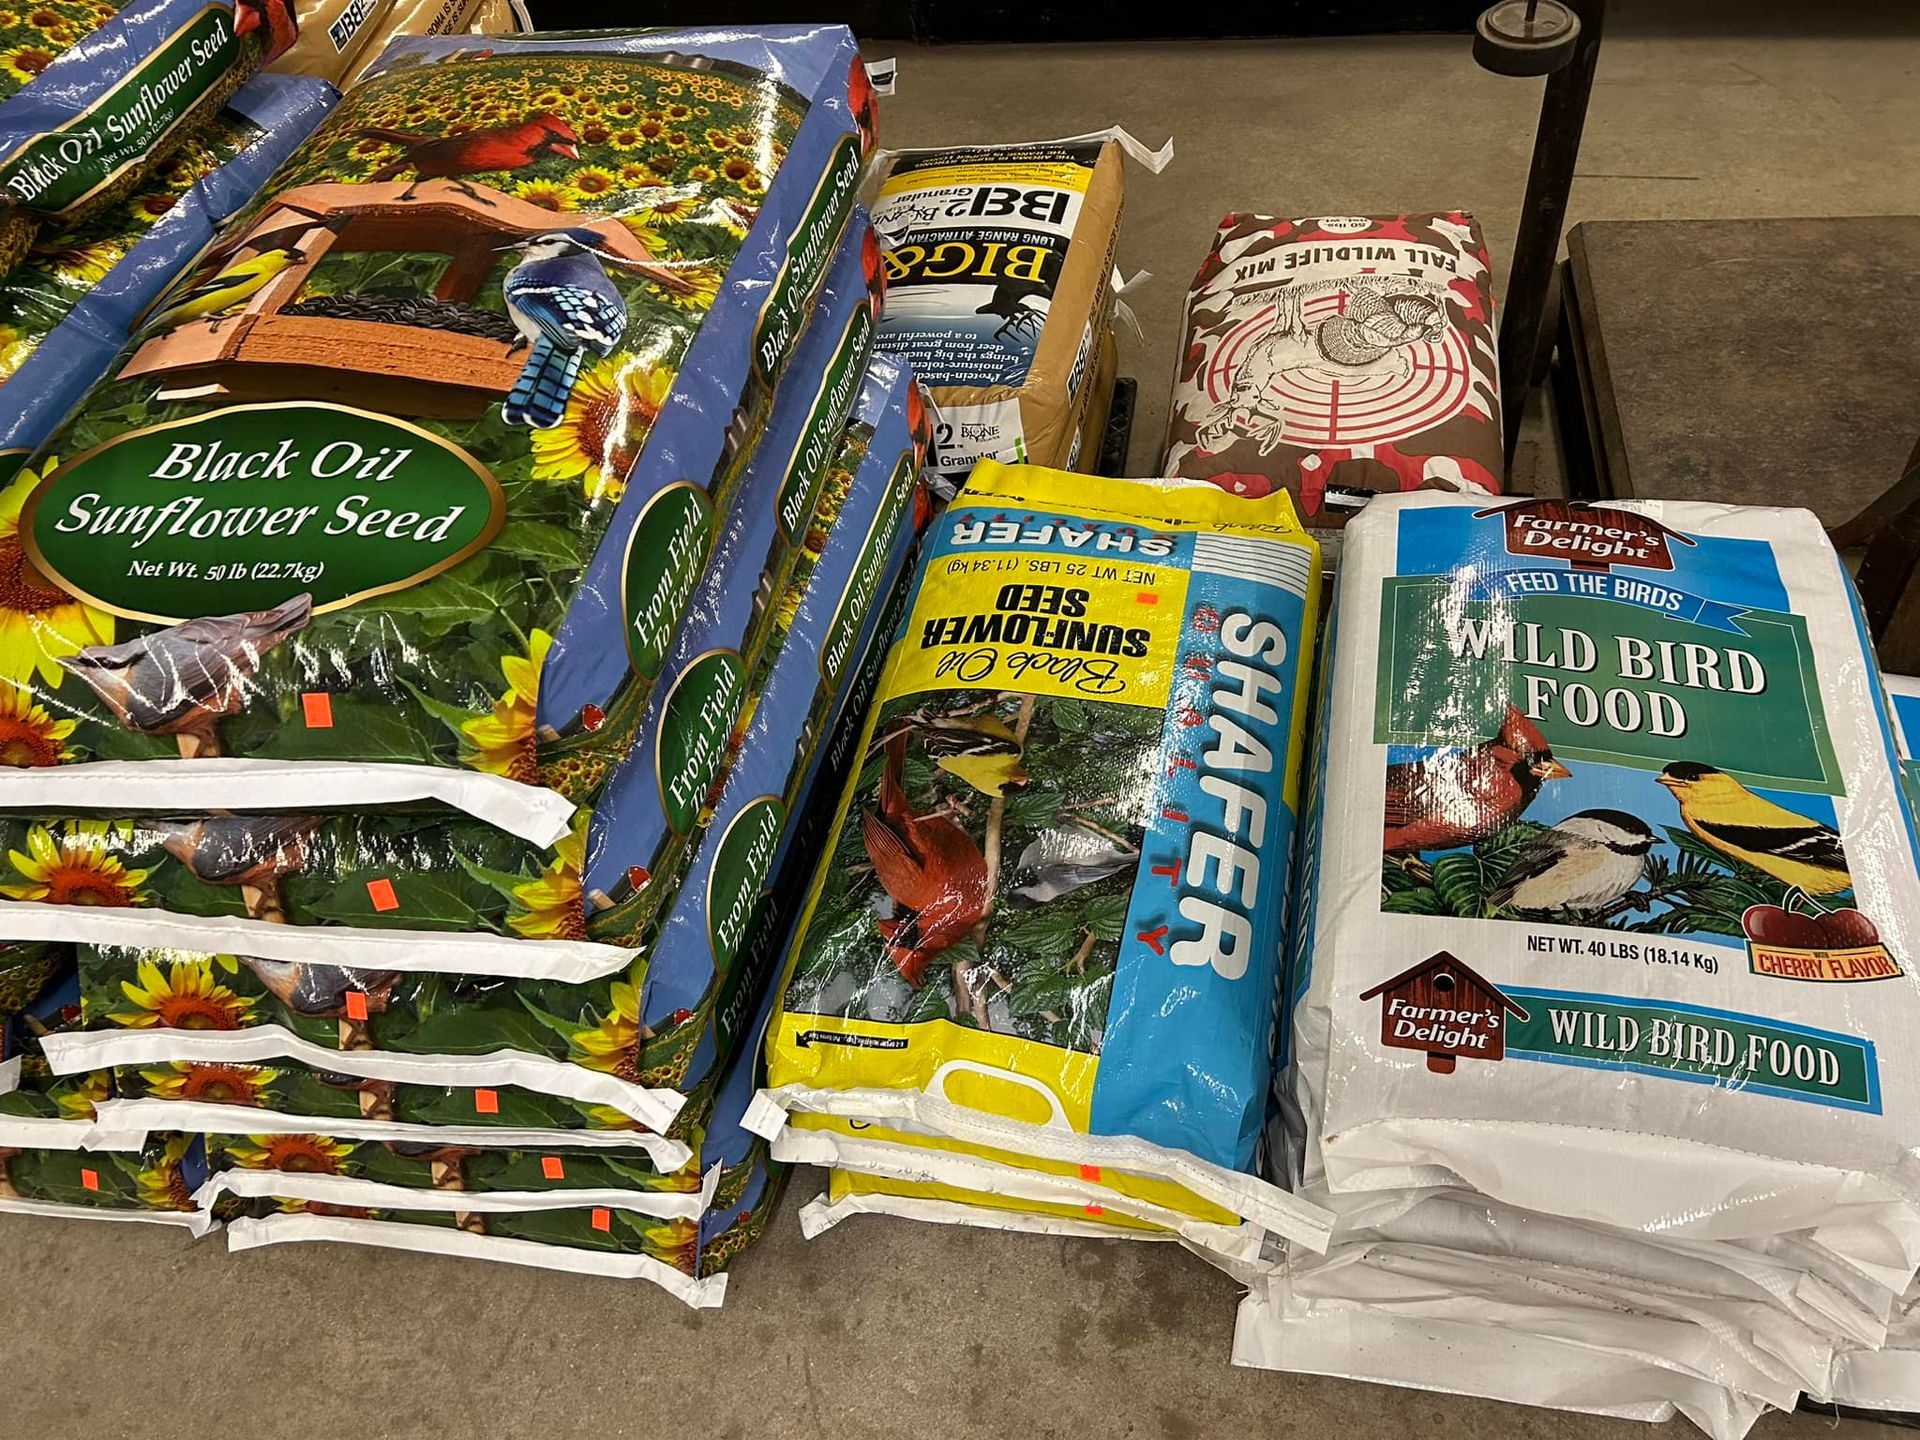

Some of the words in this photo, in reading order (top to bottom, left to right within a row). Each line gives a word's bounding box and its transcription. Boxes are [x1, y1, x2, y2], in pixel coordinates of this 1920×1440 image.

[8, 152, 68, 202] Black
[106, 62, 194, 144] Sunflower
[191, 18, 229, 66] Seed
[894, 187, 974, 205] Granular
[790, 194, 842, 283] Sunflower
[836, 151, 859, 192] Seed
[907, 230, 973, 244] ATTRACTAN
[976, 230, 1019, 244] RANGE
[1021, 232, 1056, 246] LONG
[1234, 257, 1276, 283] MIX
[1284, 245, 1397, 270] WILDLIFE
[1406, 248, 1459, 274] FALL
[873, 341, 907, 351] distan
[898, 330, 953, 341] powerful
[911, 341, 943, 350] great
[944, 342, 974, 352] from
[965, 332, 978, 340] to
[976, 343, 1005, 352] deer
[910, 360, 1004, 371] moisture-tolera
[933, 350, 956, 360] big
[957, 351, 978, 359] the
[980, 352, 1020, 364] brings
[913, 371, 1001, 382] Protein-based,
[782, 474, 812, 533] Black
[805, 433, 823, 475] Oil
[819, 359, 856, 437] Sunflower
[852, 312, 870, 361] Seed
[149, 438, 300, 482] Black
[309, 440, 413, 482] Oil
[54, 492, 319, 549] Sunflower
[323, 495, 466, 543] Seed
[1513, 513, 1660, 548] Farmer's
[950, 520, 1173, 557] SHAFER
[1523, 529, 1650, 560] Delight
[127, 559, 163, 578] Net
[167, 561, 199, 579] Wt.
[204, 564, 225, 582] 50
[227, 561, 247, 580] lb
[250, 561, 325, 583] (22.7kg)
[633, 575, 673, 648] From
[667, 492, 703, 571] Field
[827, 620, 853, 680] Black
[850, 583, 865, 622] Oil
[862, 508, 899, 593] Sunflower
[895, 461, 912, 508] Seed
[946, 559, 971, 576] kg)
[973, 557, 1020, 573] (11.34
[1025, 559, 1061, 574] LBS.
[1066, 563, 1086, 577] 25
[1090, 567, 1119, 582] WT
[1121, 570, 1156, 586] NET
[996, 583, 1090, 615] SEED
[1506, 570, 1561, 594] FEED
[1564, 573, 1608, 596] THE
[1613, 578, 1684, 612] BIRDS
[653, 626, 670, 659] To
[921, 613, 1150, 658] SUNFLOWER
[935, 647, 999, 682] Oil
[1454, 616, 1598, 674] WILD
[1613, 633, 1767, 695] BIRD
[1007, 655, 1126, 694] Black
[1522, 673, 1688, 739] FOOD
[669, 736, 709, 810] From
[700, 658, 736, 733] Field
[690, 785, 708, 815] To
[1169, 612, 1287, 981] SHAFER
[717, 877, 751, 951] From
[746, 805, 777, 876] Field
[1527, 934, 1558, 953] NET
[1560, 936, 1585, 956] WT.
[1588, 938, 1607, 957] 40
[1610, 940, 1640, 961] LBS
[1644, 944, 1692, 968] (18.14
[1694, 951, 1719, 975] Kg)
[1757, 953, 1828, 978] CHERRY
[1830, 954, 1901, 979] FLAVOR
[1387, 998, 1500, 1030] Farmer's
[1392, 1018, 1490, 1050] Delight
[1547, 1008, 1640, 1052] WILD
[1649, 1018, 1738, 1068] BIRD
[1744, 1033, 1841, 1086] FOOD
